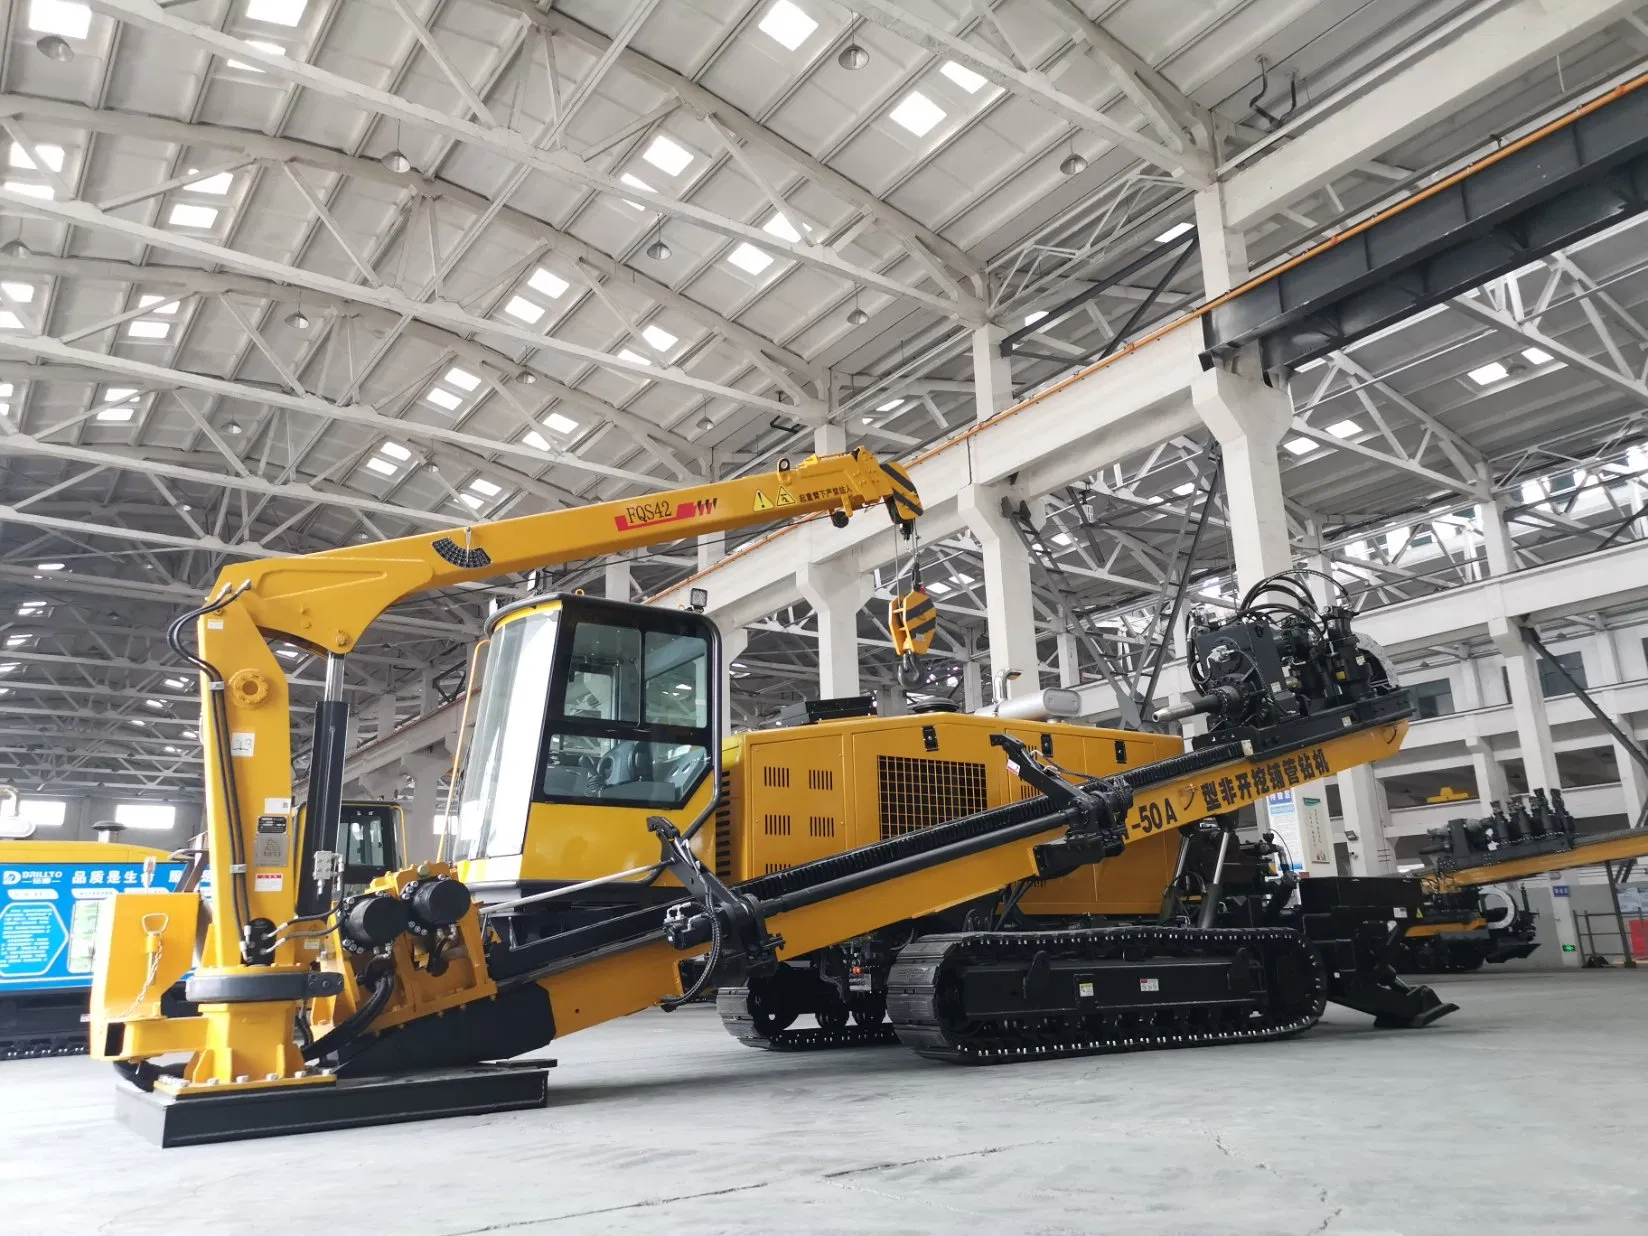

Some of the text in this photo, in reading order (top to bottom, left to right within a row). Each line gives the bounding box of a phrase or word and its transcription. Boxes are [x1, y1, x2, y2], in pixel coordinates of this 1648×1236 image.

[626, 500, 672, 523] FQS42
[1200, 748, 1330, 812] 型非开挖铺管钻机
[22, 871, 63, 879] DRILLTO
